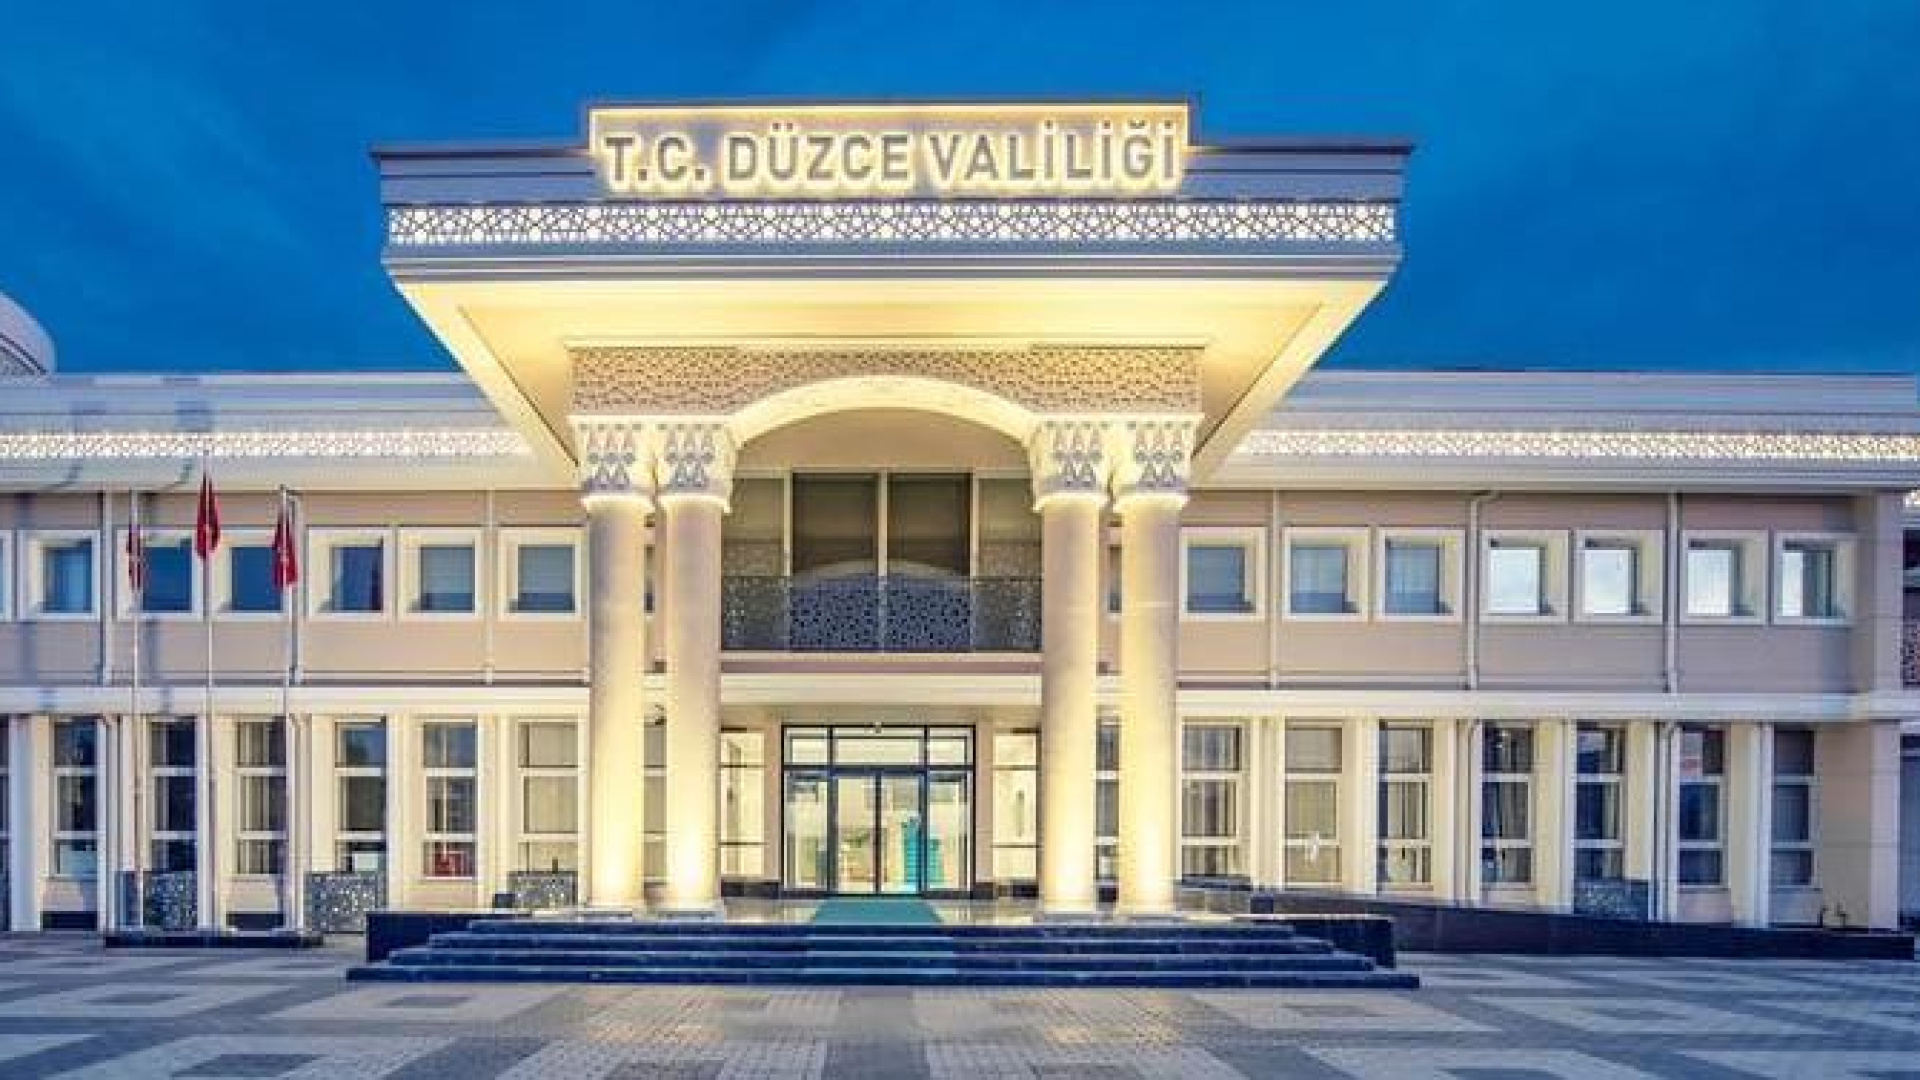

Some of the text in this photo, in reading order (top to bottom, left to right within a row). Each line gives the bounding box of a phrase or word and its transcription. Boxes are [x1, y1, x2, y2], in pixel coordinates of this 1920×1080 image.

[605, 120, 1176, 181] T.C. DÜZCE VALİLİĞİ
